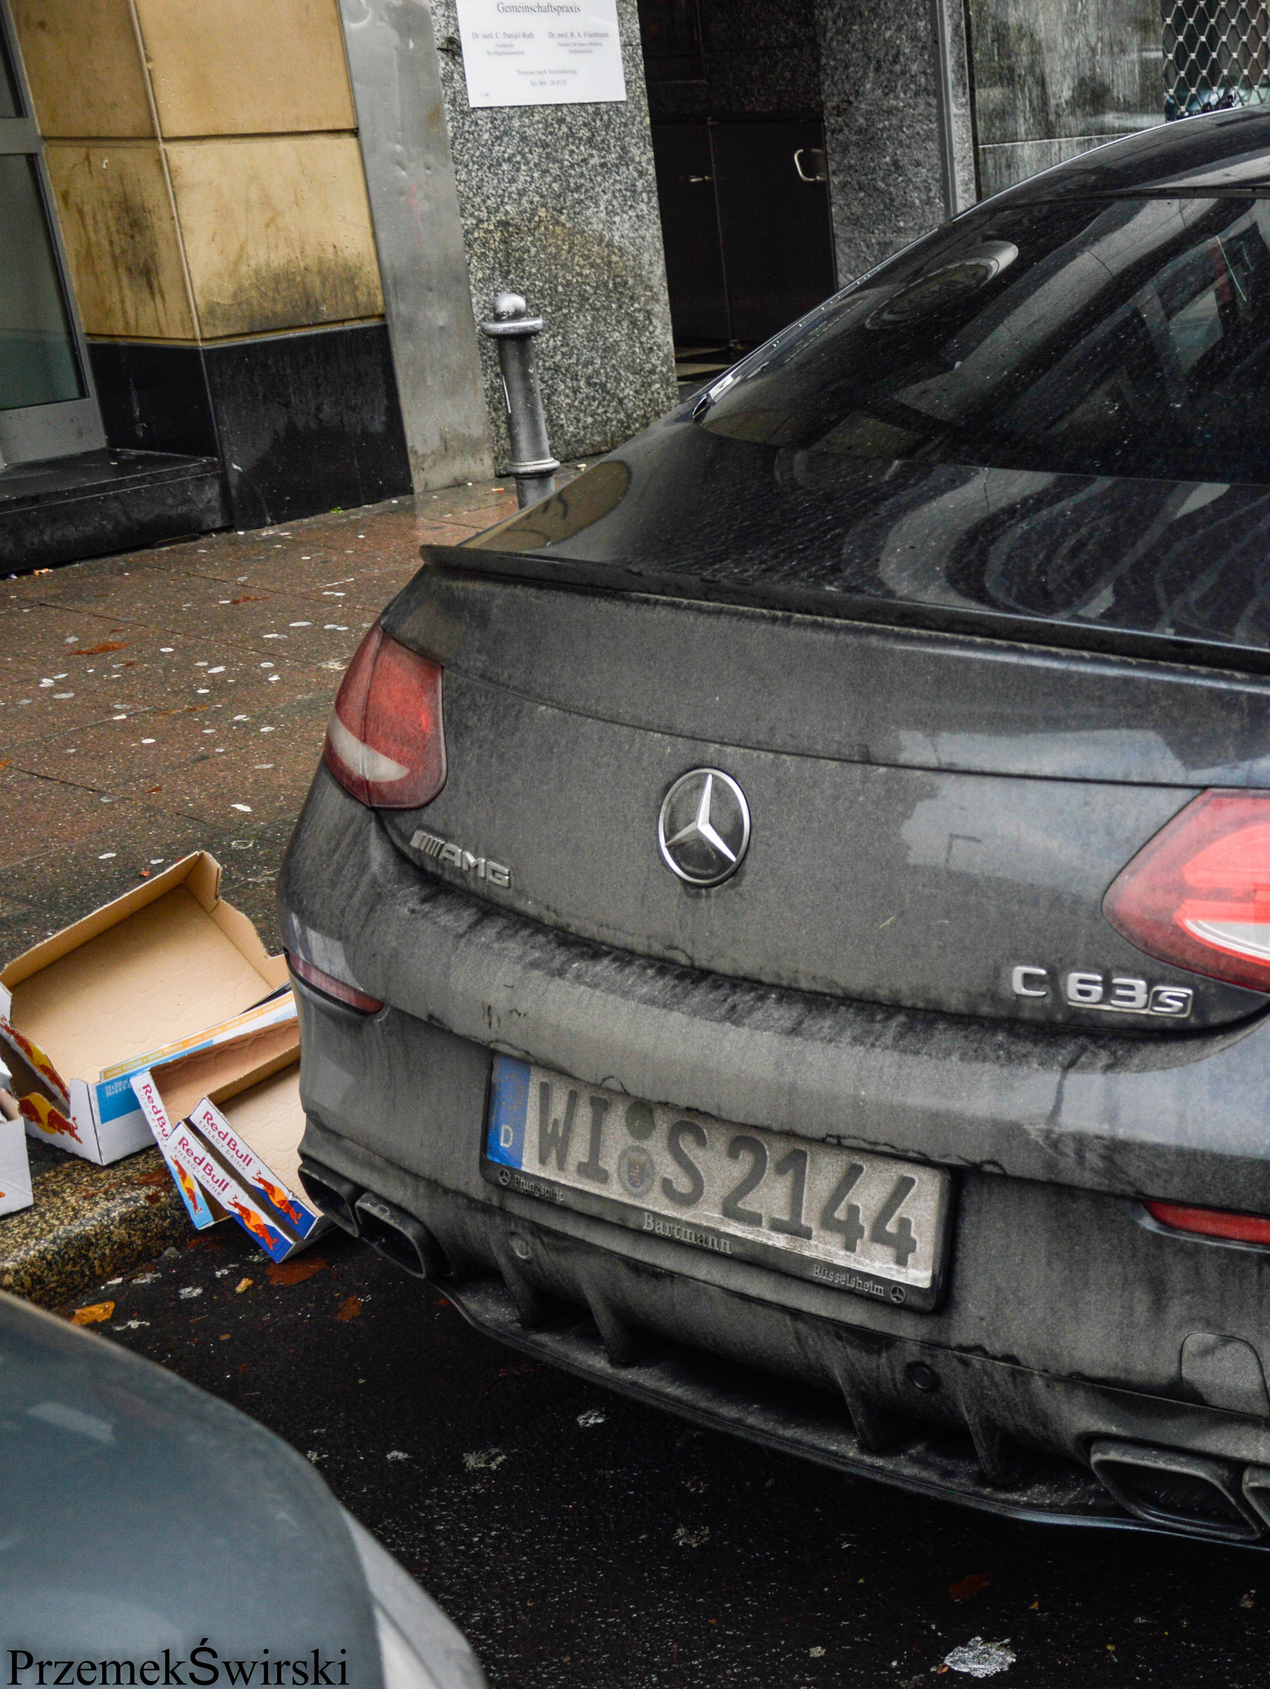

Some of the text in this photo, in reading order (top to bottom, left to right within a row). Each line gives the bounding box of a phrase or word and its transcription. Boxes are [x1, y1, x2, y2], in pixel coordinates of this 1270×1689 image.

[496, 2, 581, 16] Gemeinschaftspraxis
[1012, 965, 1048, 997] C
[198, 1120, 246, 1172] ENERGY DRINK
[500, 1125, 513, 1149] D
[537, 1081, 612, 1185] WI
[174, 1145, 200, 1174] ENERGY
[642, 1212, 733, 1255] Bartmann
[812, 1264, 886, 1298] Rüsselsheim
